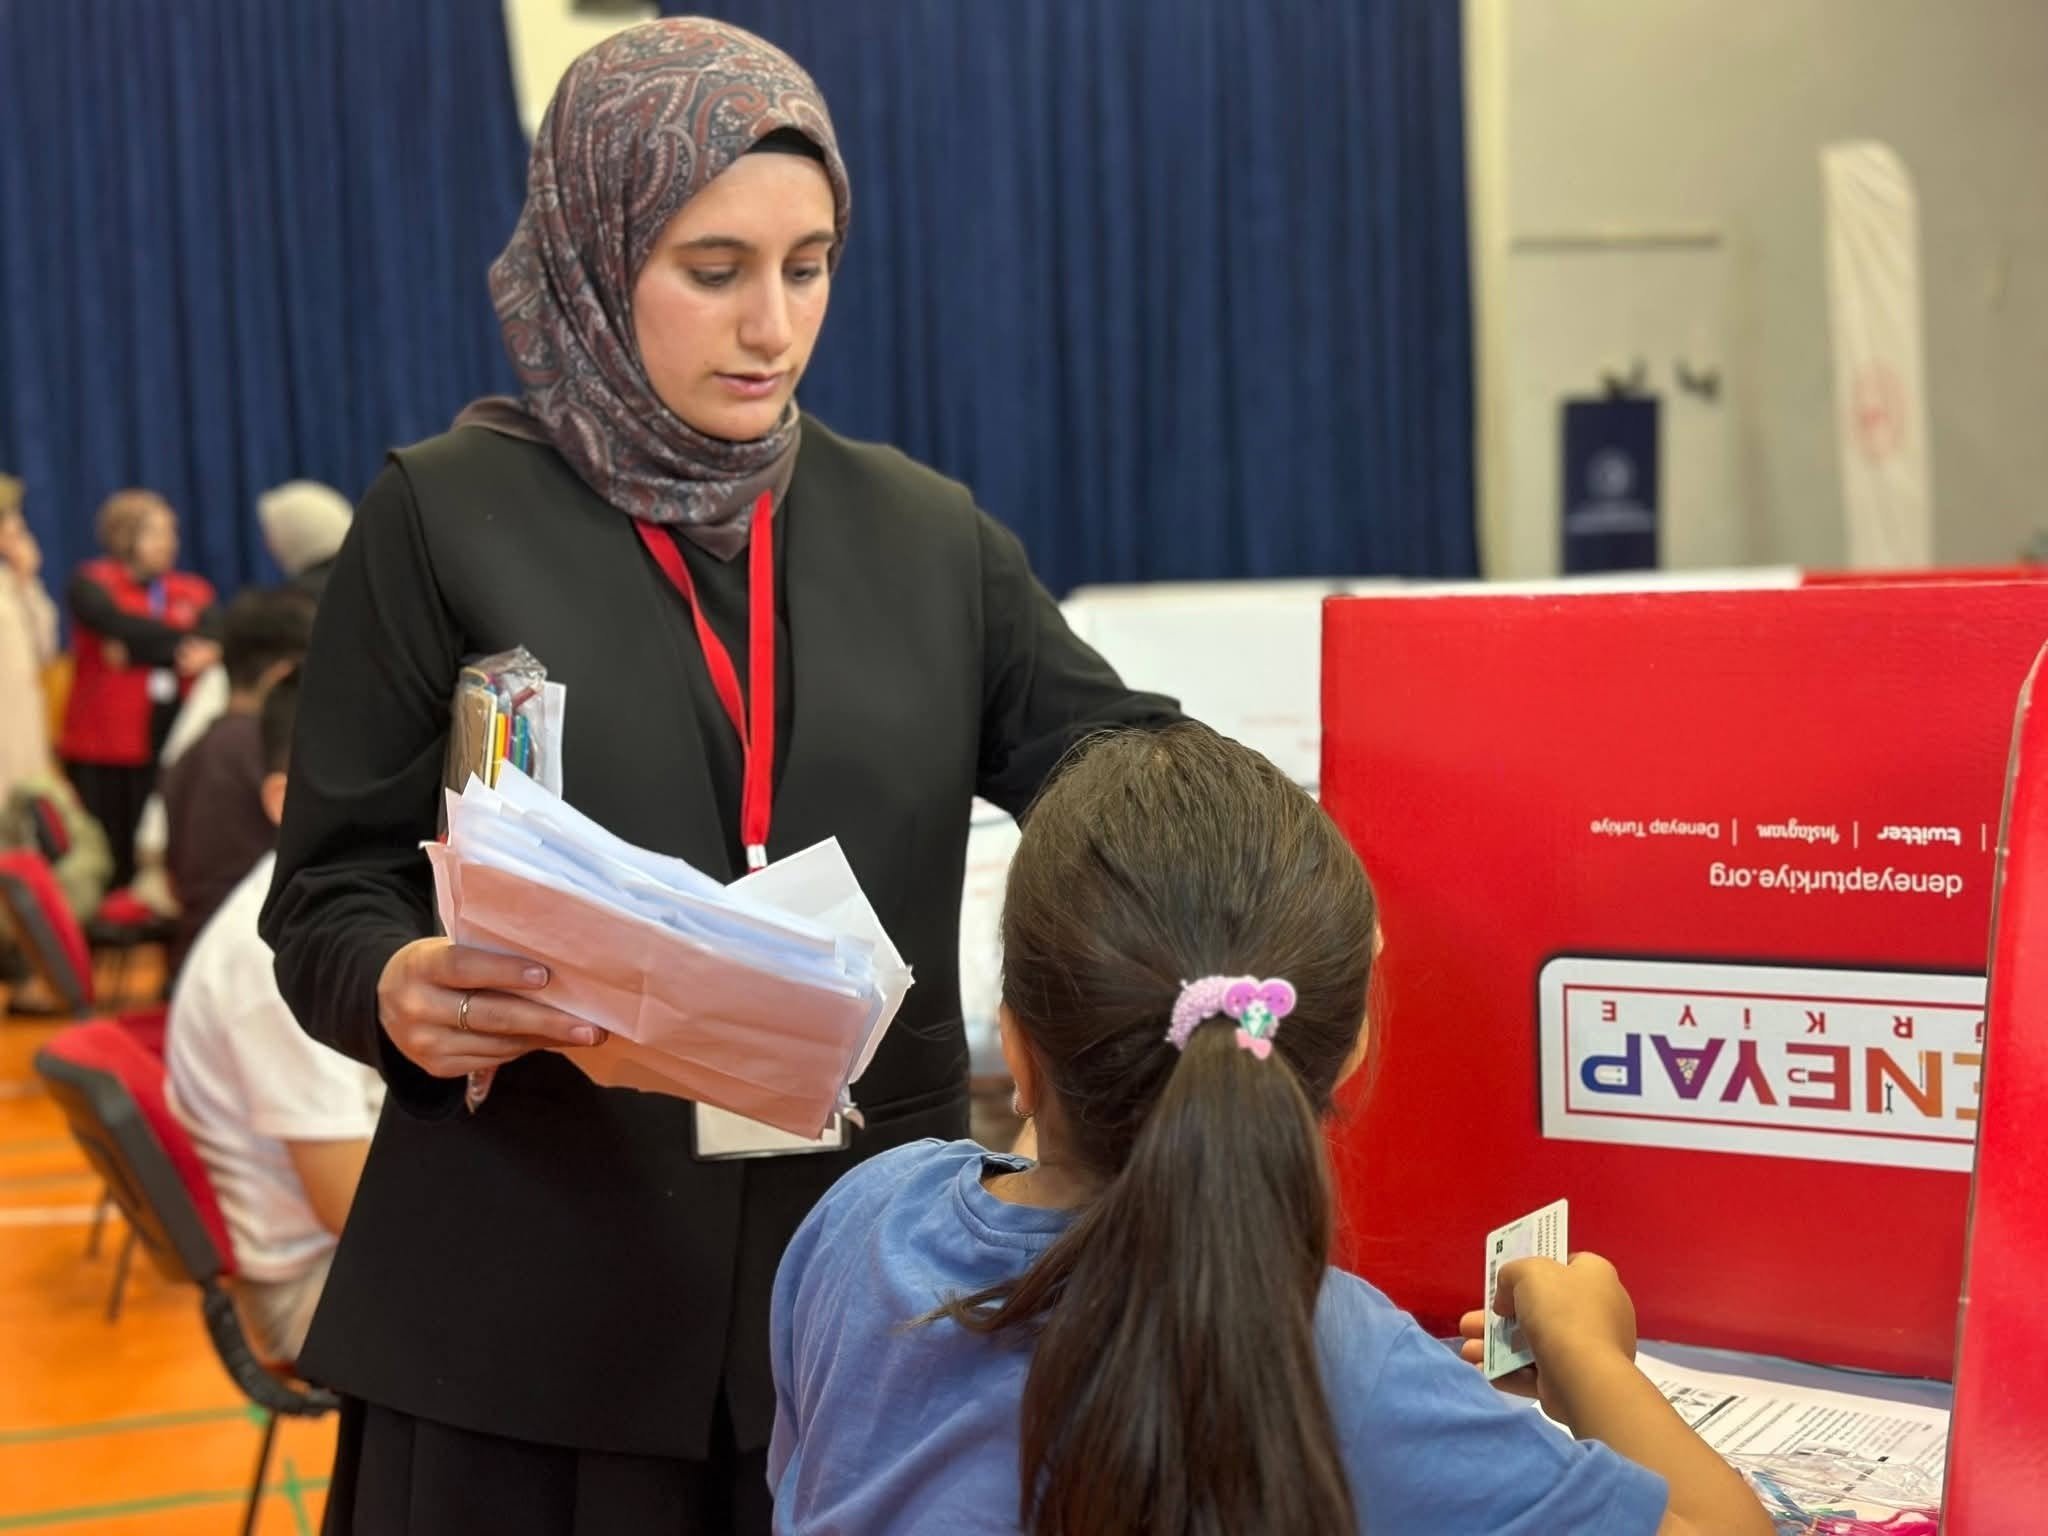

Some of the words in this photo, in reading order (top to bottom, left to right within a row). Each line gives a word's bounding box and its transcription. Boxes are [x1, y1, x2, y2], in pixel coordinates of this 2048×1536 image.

[1649, 819, 1720, 838] Deneyap
[1757, 818, 1839, 844] Instagram
[1877, 826, 1961, 845] twitter
[1710, 862, 1963, 898] deneyapturkiye.org
